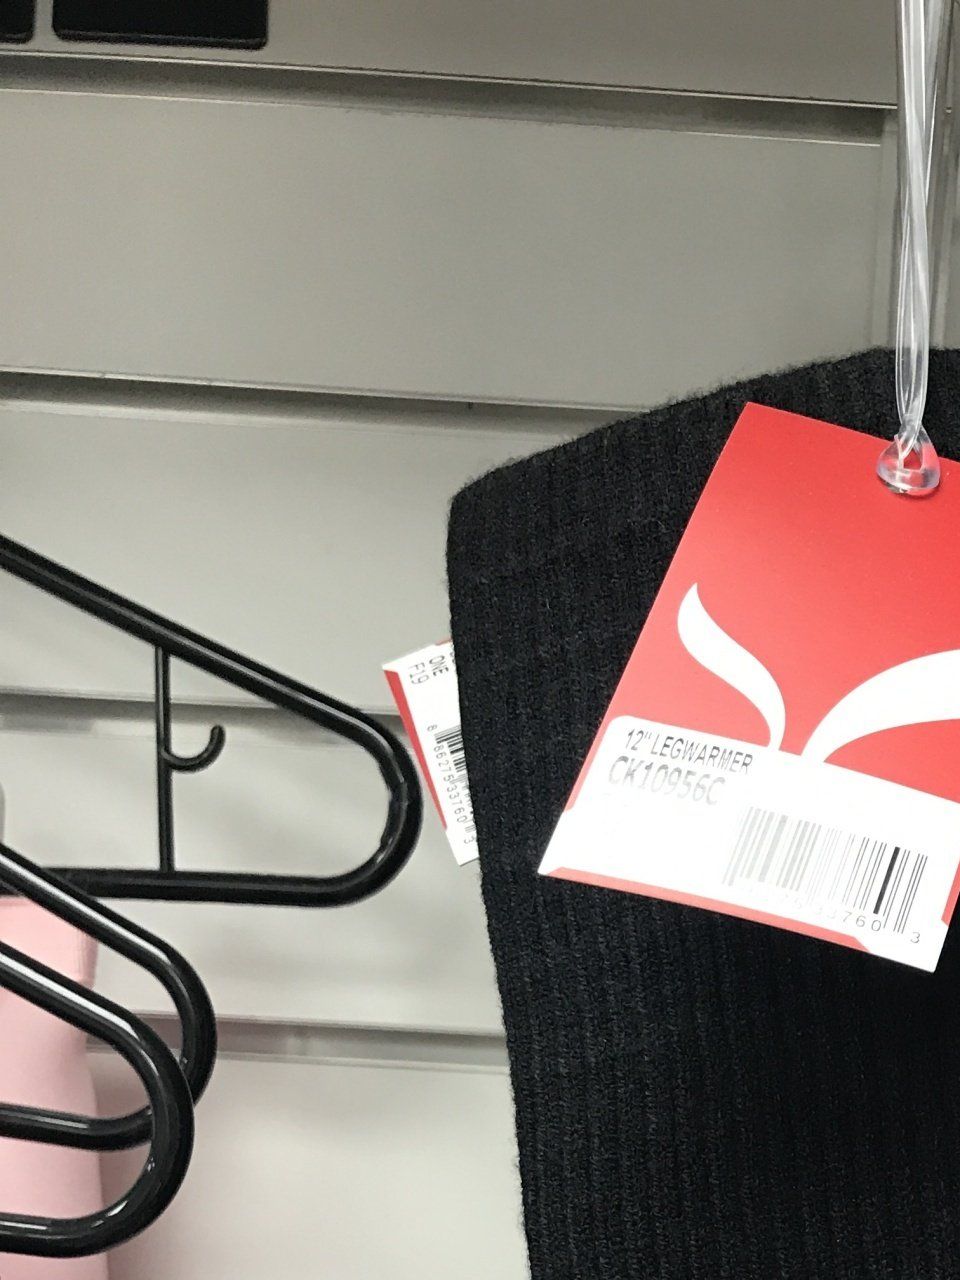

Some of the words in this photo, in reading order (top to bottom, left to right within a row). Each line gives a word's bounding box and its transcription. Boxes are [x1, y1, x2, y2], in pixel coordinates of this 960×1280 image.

[408, 662, 429, 685] F19
[429, 655, 449, 677] ONE
[651, 734, 753, 774] LEGWARMER
[608, 756, 725, 804] CK10956C
